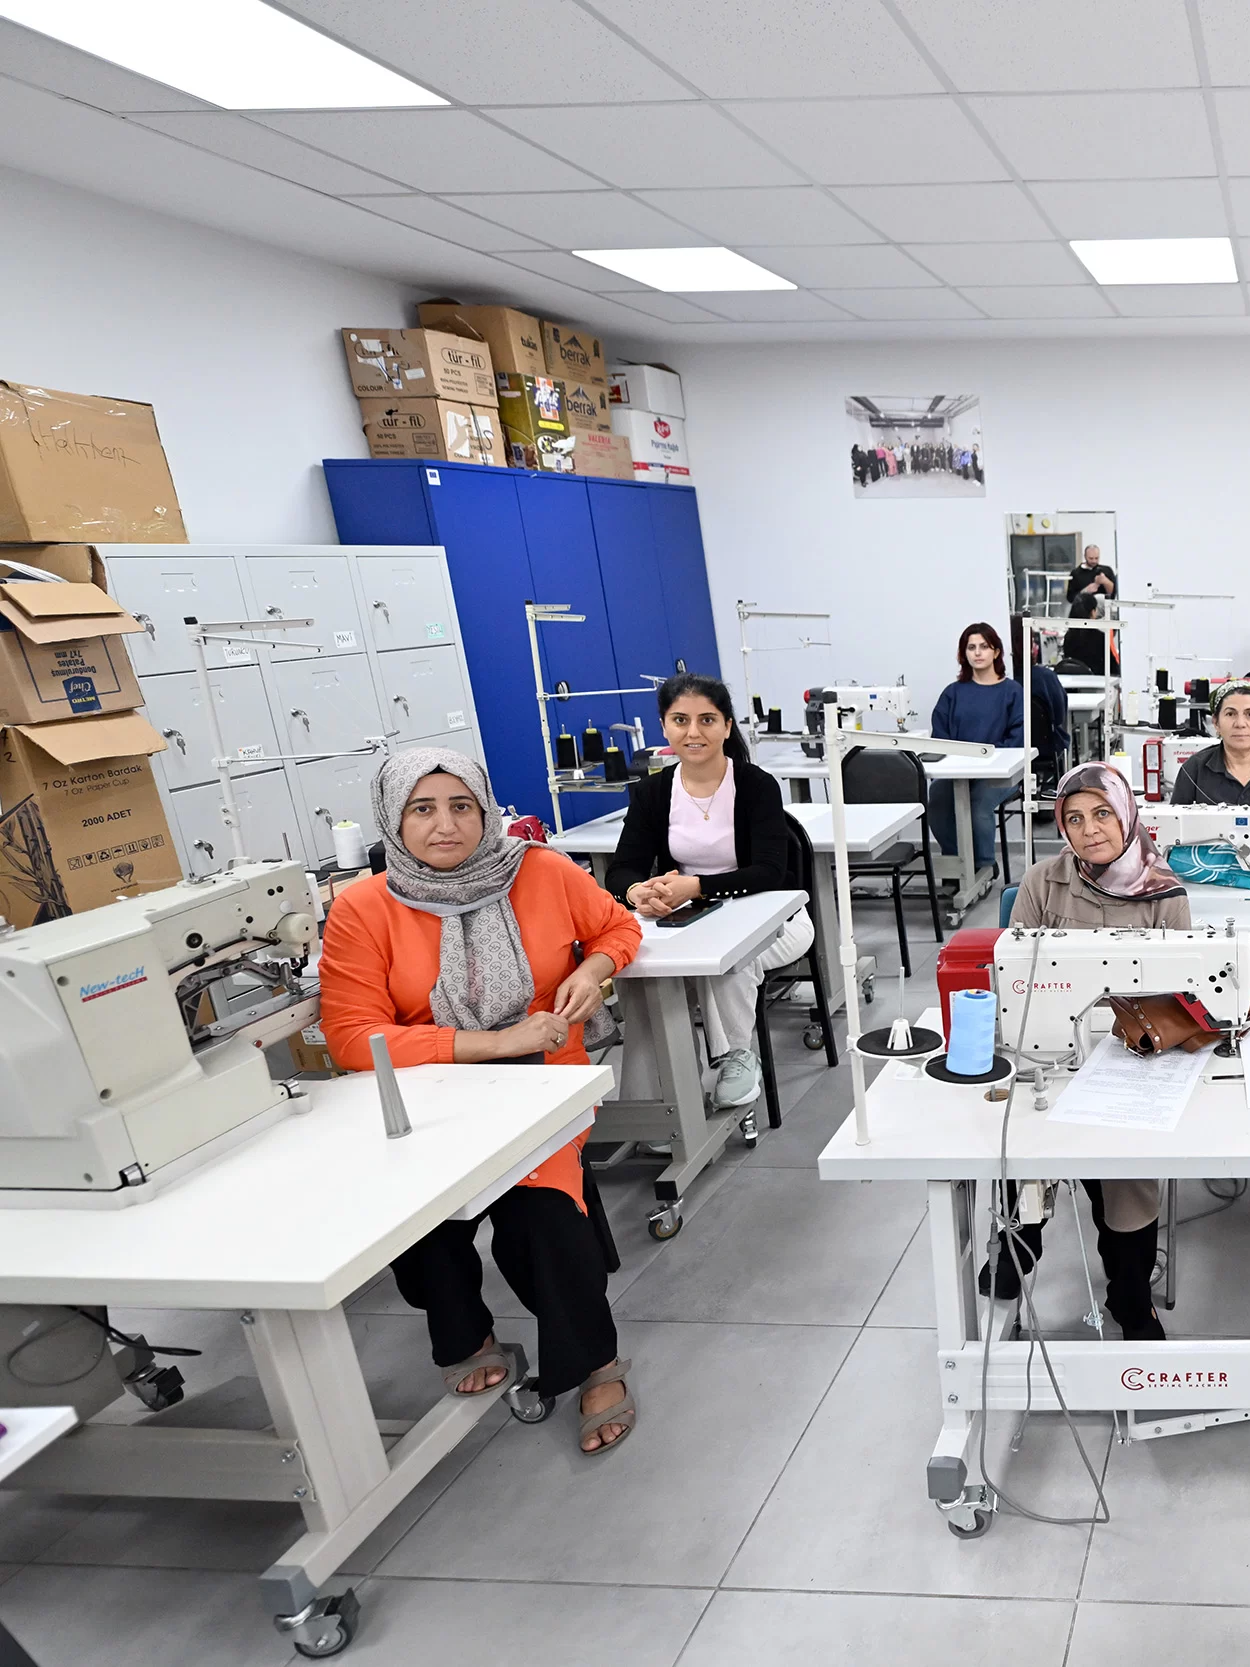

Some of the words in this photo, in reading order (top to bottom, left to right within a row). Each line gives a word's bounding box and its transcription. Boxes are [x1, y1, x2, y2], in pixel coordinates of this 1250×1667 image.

[470, 355, 482, 369] fil
[560, 345, 591, 367] berrak
[565, 396, 598, 417] berrak
[408, 415, 422, 427] fil
[69, 681, 91, 693] Chef
[42, 782, 48, 790] 7
[52, 779, 67, 789] Oz
[70, 772, 105, 786] Karton
[107, 764, 142, 778] Bardak
[81, 816, 105, 828] 2000
[106, 808, 133, 821] ADET
[1147, 1372, 1228, 1382] CRAFTER
